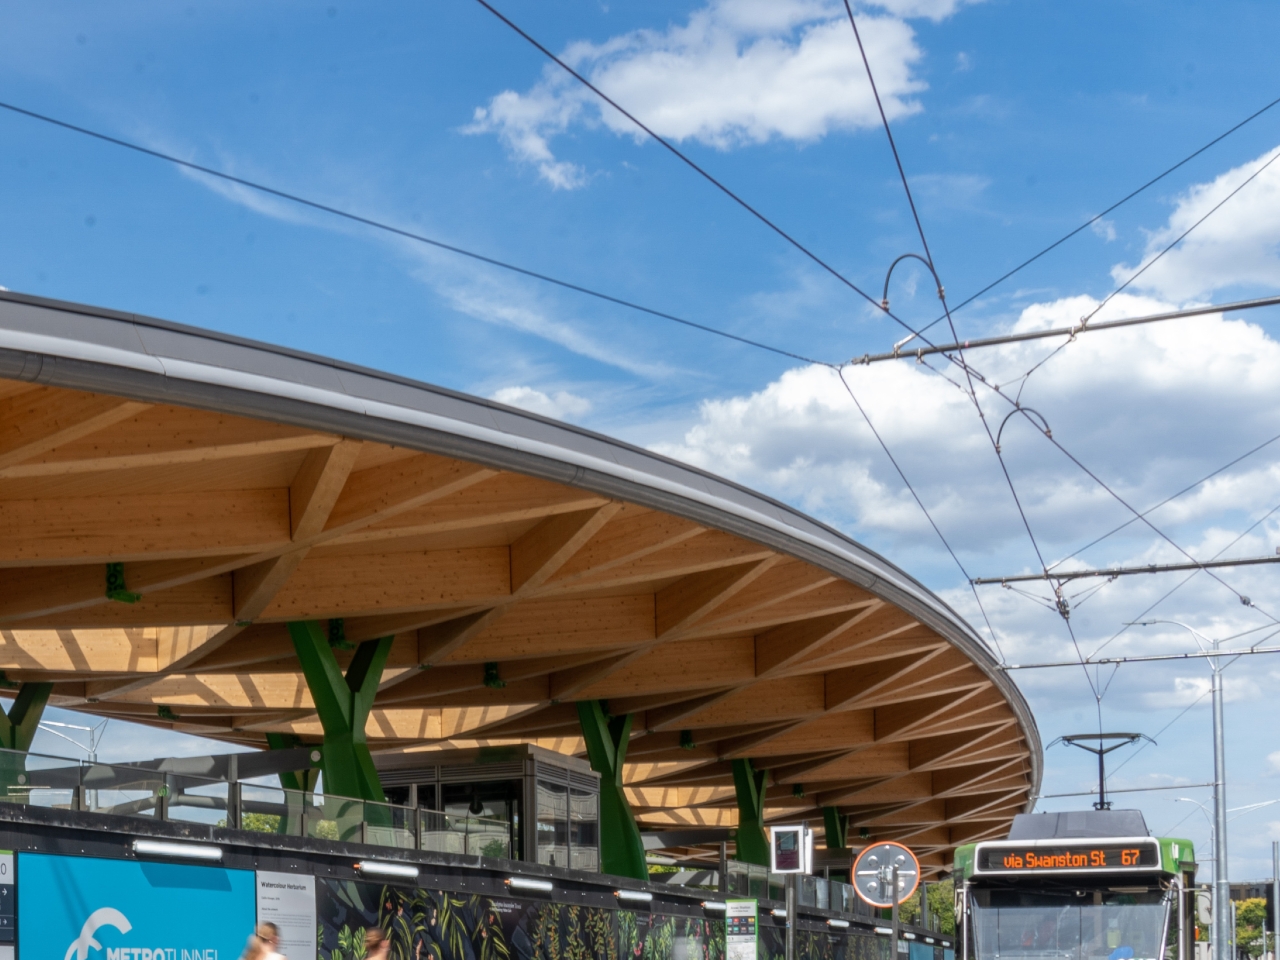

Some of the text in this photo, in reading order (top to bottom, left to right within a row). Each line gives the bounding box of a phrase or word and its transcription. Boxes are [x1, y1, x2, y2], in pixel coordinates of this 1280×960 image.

[1004, 850, 1140, 868] via Swanston St 67
